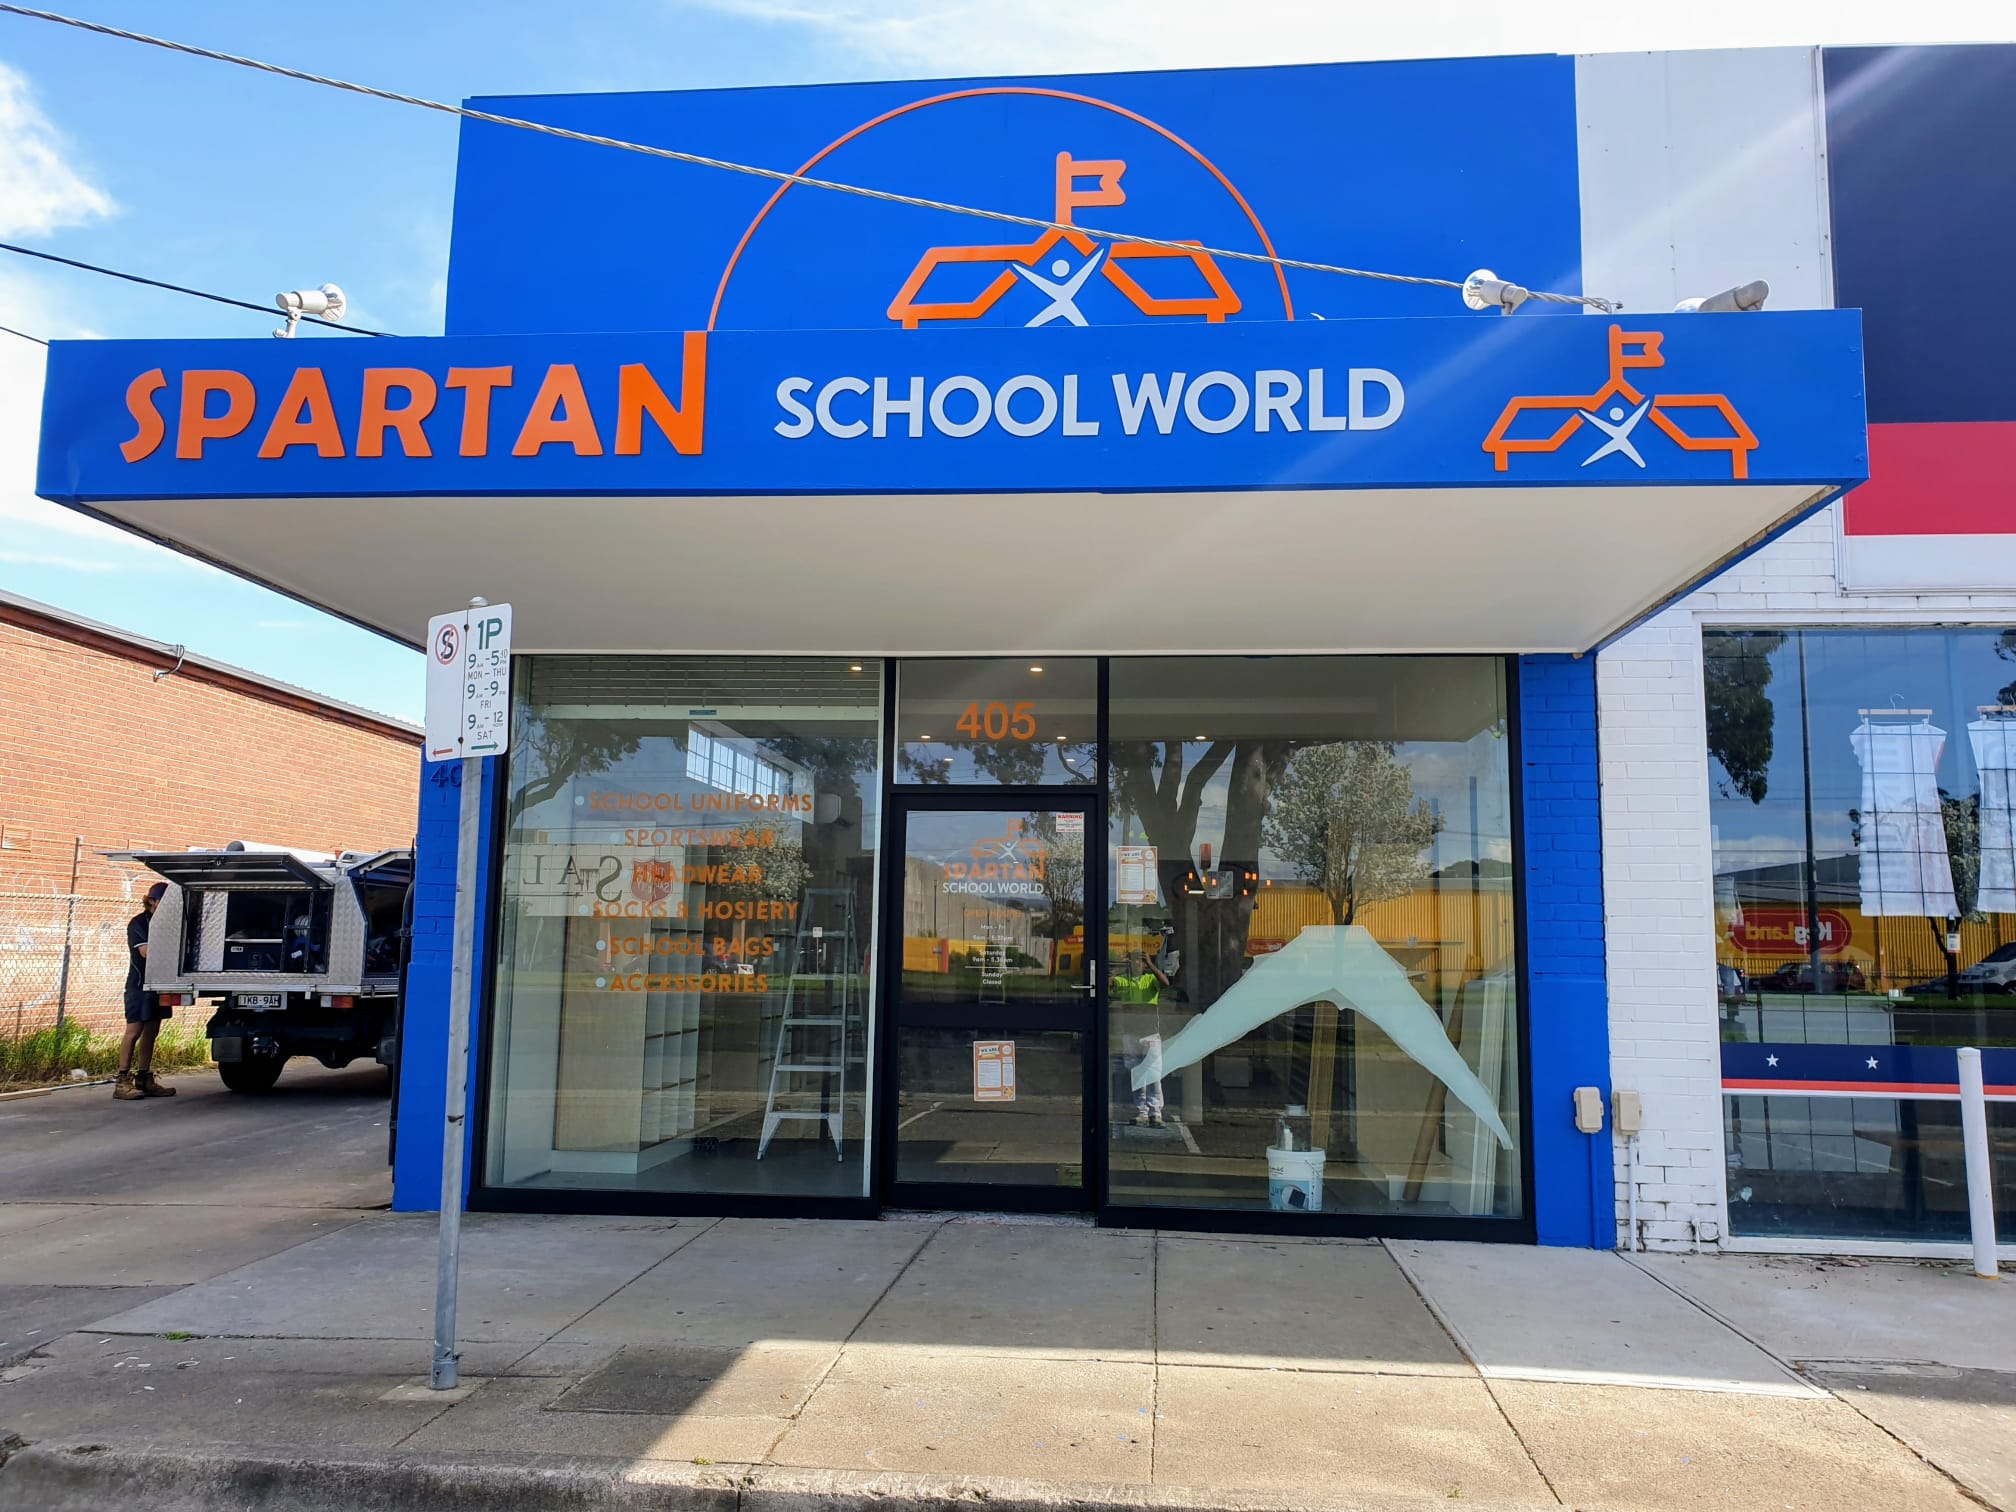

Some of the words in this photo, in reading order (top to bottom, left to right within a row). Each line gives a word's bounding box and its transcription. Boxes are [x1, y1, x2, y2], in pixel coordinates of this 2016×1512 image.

[119, 330, 707, 463] SPARTAN
[774, 374, 1100, 439] SCHOOL
[1112, 368, 1405, 436] WORLD
[478, 618, 503, 650] 1P
[468, 671, 483, 680] MON
[493, 666, 507, 677] THU
[480, 700, 492, 709] FRI
[494, 711, 503, 722] 12
[956, 702, 1036, 740] 405
[477, 731, 494, 740] SAT
[589, 792, 685, 811] SCHOOL
[691, 793, 813, 812] UNIFORMS
[624, 828, 774, 848] SPORTSWEAR
[632, 863, 764, 884] HEADWEAR
[944, 860, 1046, 880] SPARTAN
[942, 882, 996, 893] SCHOOL
[998, 882, 1044, 894] WORLD
[592, 901, 668, 920] SOCKS
[698, 901, 799, 920] HOSIERY
[609, 936, 705, 956] SCHOOL
[713, 937, 774, 956] BAGS
[609, 974, 769, 993] ACCESSORIES
